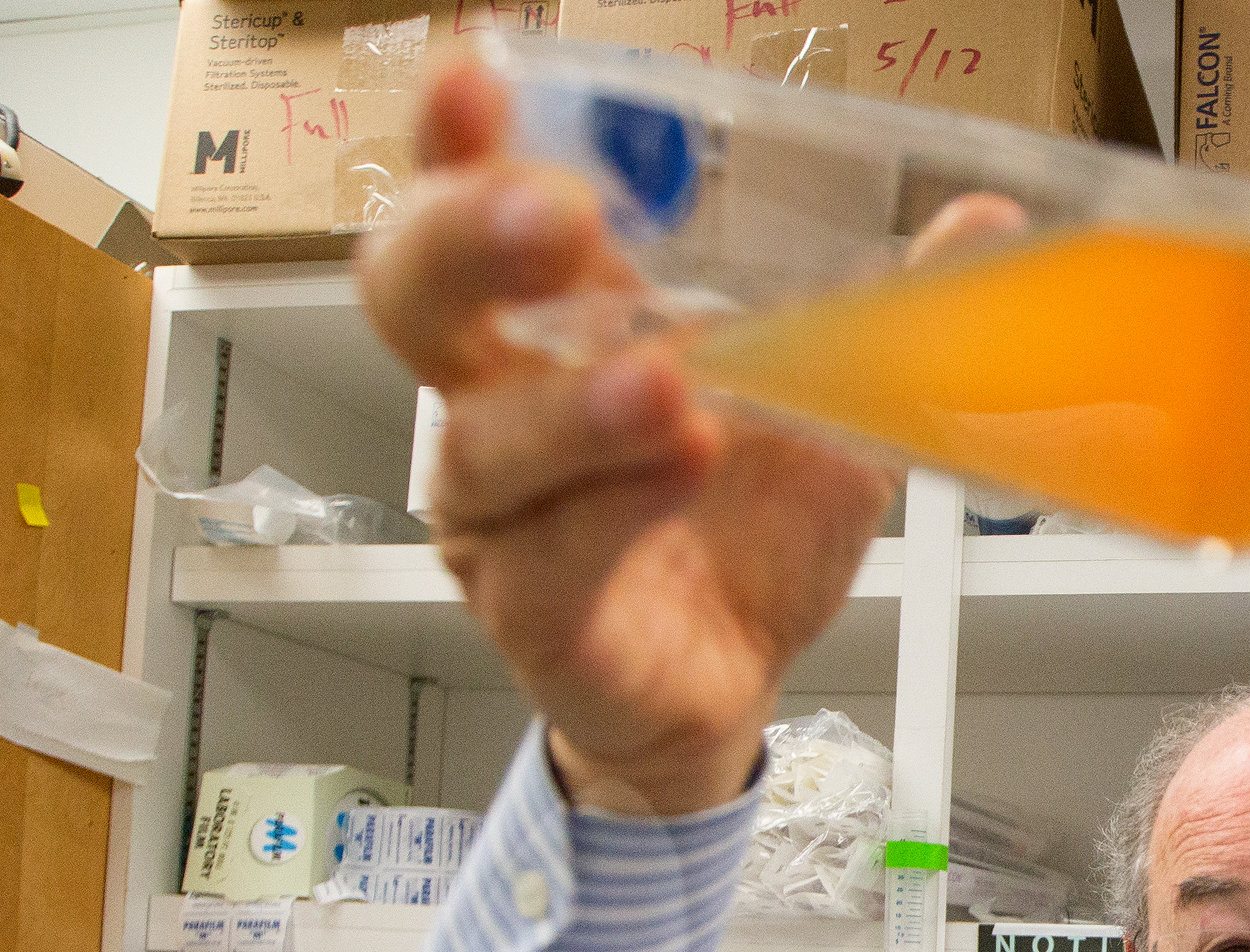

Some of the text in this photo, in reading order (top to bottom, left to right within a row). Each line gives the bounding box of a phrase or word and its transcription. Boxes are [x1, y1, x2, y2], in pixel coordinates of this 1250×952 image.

[292, 11, 305, 27] &
[205, 69, 288, 79] Filtration Systems
[207, 57, 273, 67] Vacuum-driven
[873, 28, 982, 98] 5/12
[1223, 55, 1233, 81] Brand
[1222, 84, 1234, 117] Corning
[281, 88, 349, 166] Full
[190, 128, 251, 175] M MILLIPORE
[195, 816, 212, 849] FILM
[200, 788, 233, 880] LABORATORY
